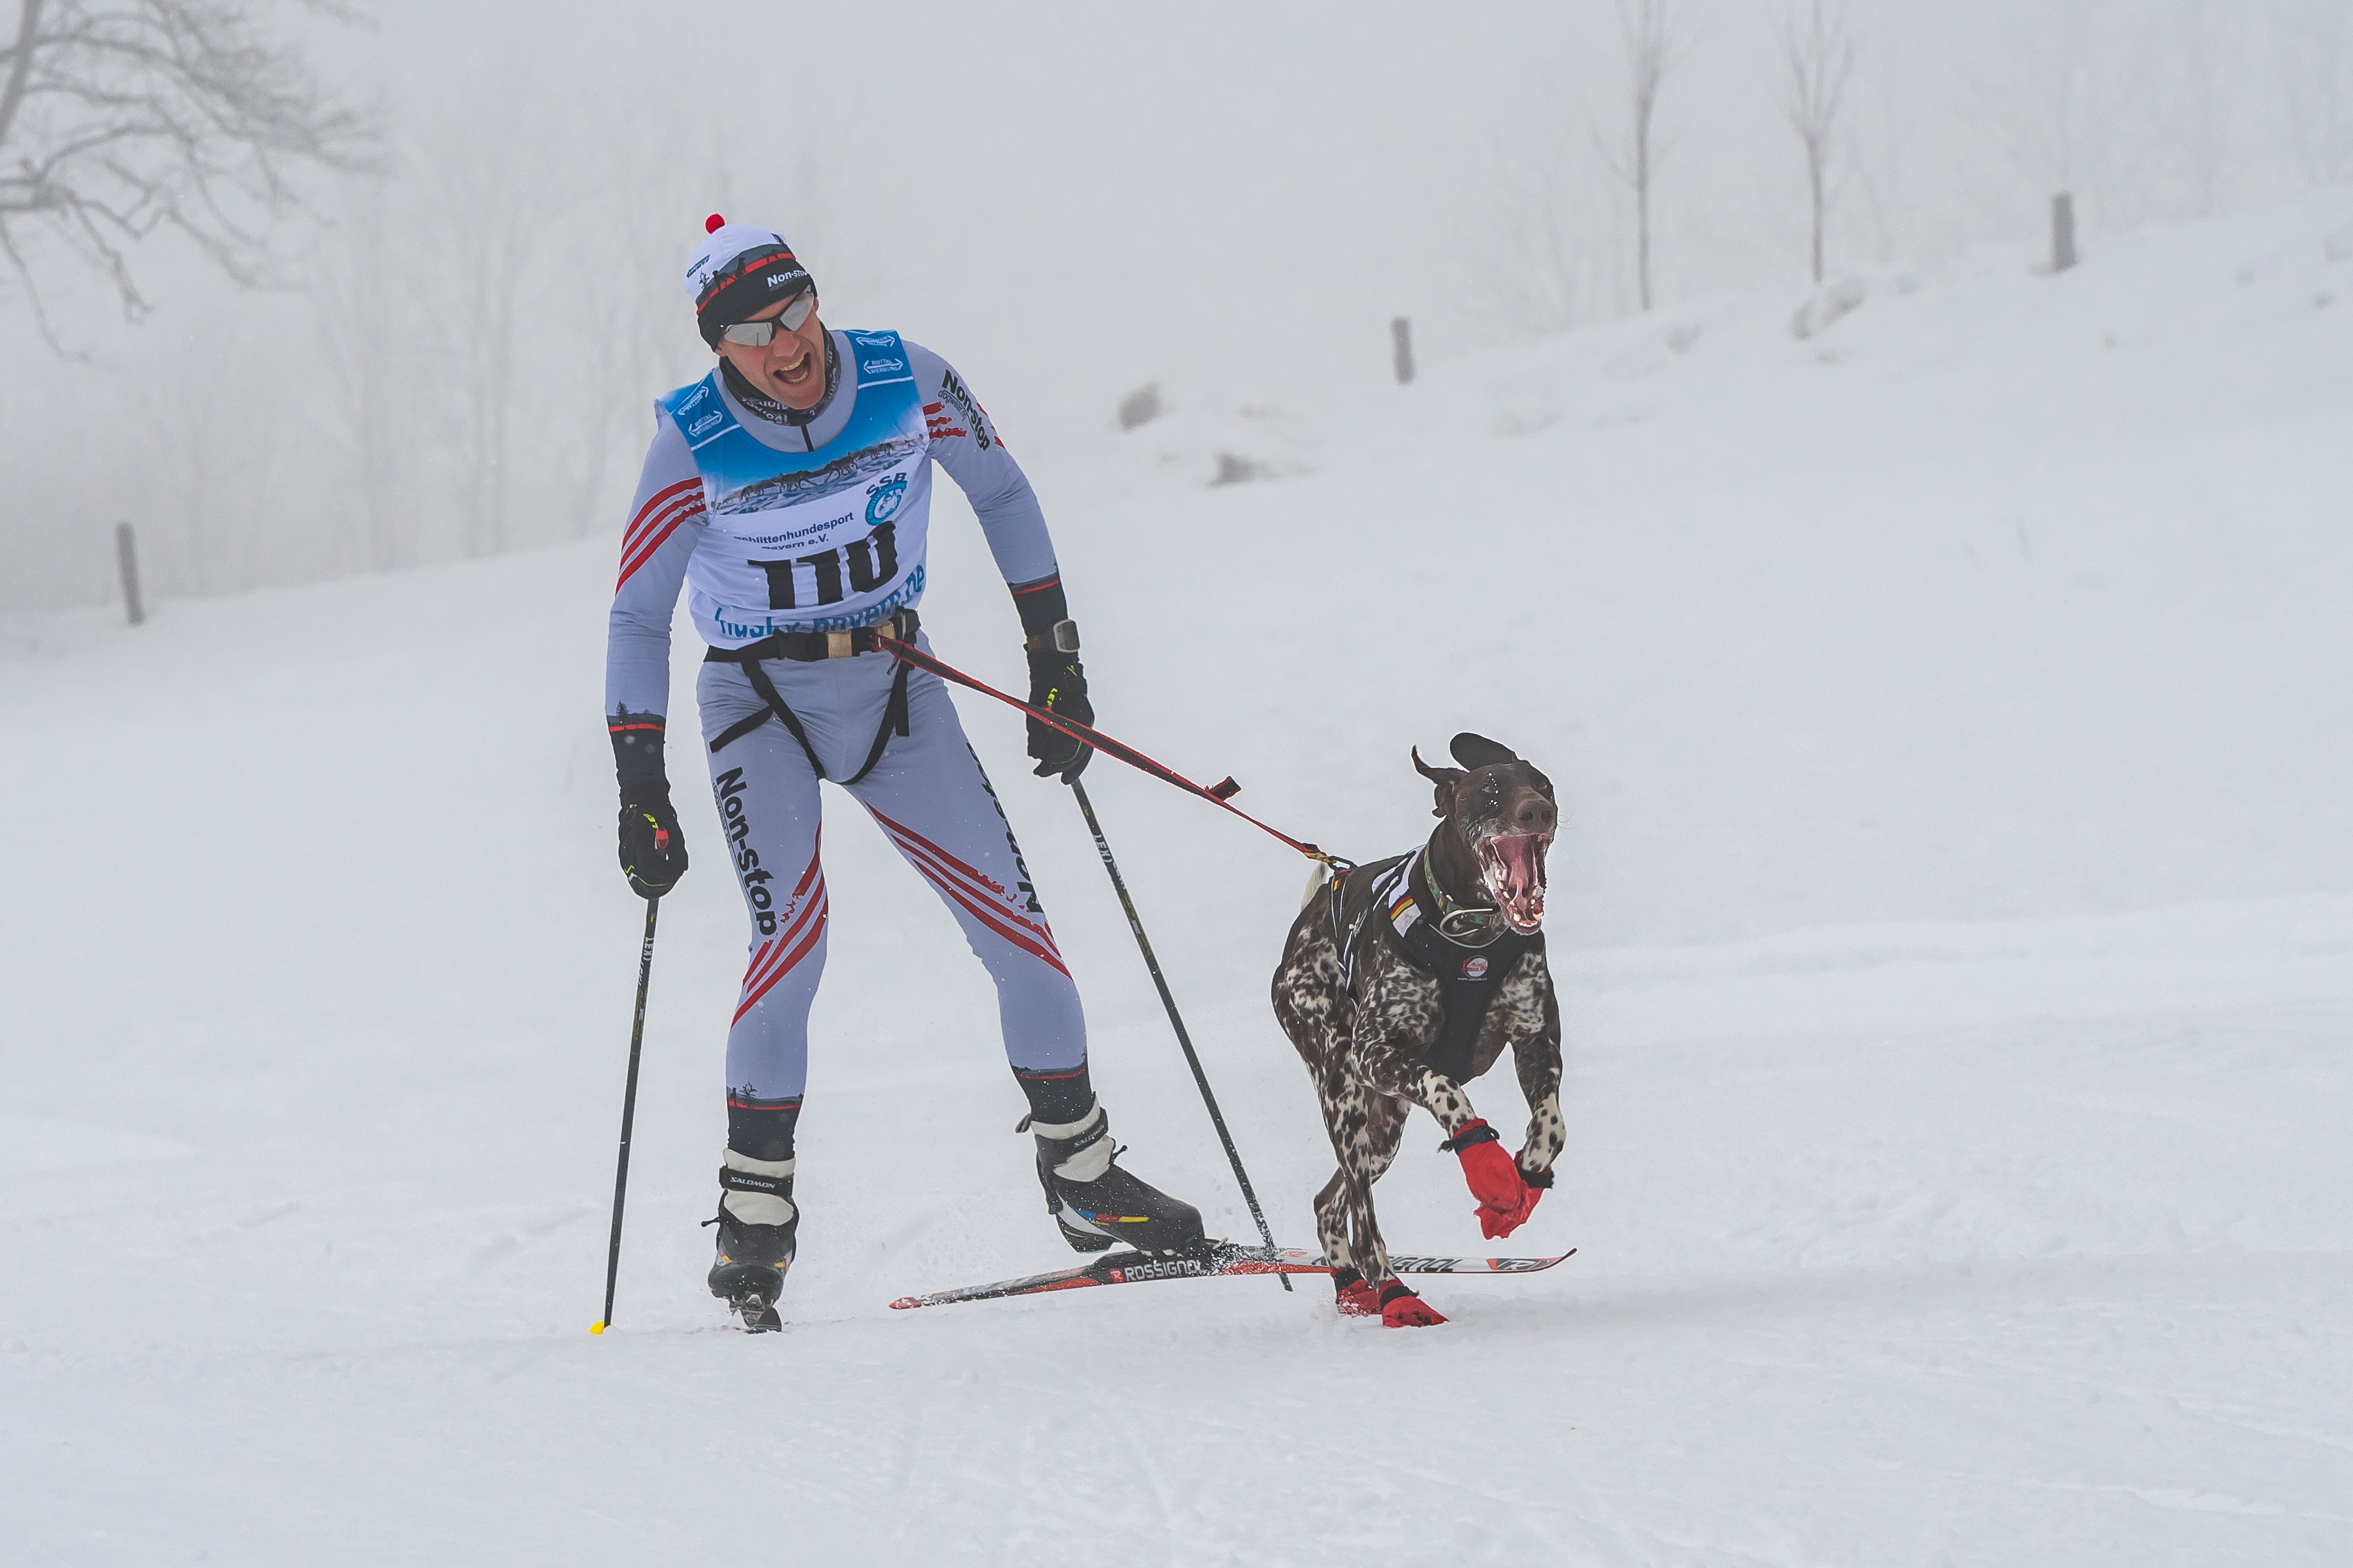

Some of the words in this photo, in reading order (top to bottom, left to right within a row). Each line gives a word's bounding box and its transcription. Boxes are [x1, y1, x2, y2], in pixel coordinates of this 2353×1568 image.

[941, 369, 990, 451] Non-stop
[866, 472, 907, 498] SSB
[747, 520, 899, 610] 110
[716, 766, 777, 936] Non-stop
[730, 1176, 776, 1189] SALOMON
[1124, 1259, 1205, 1282] ROSSIGNOL
